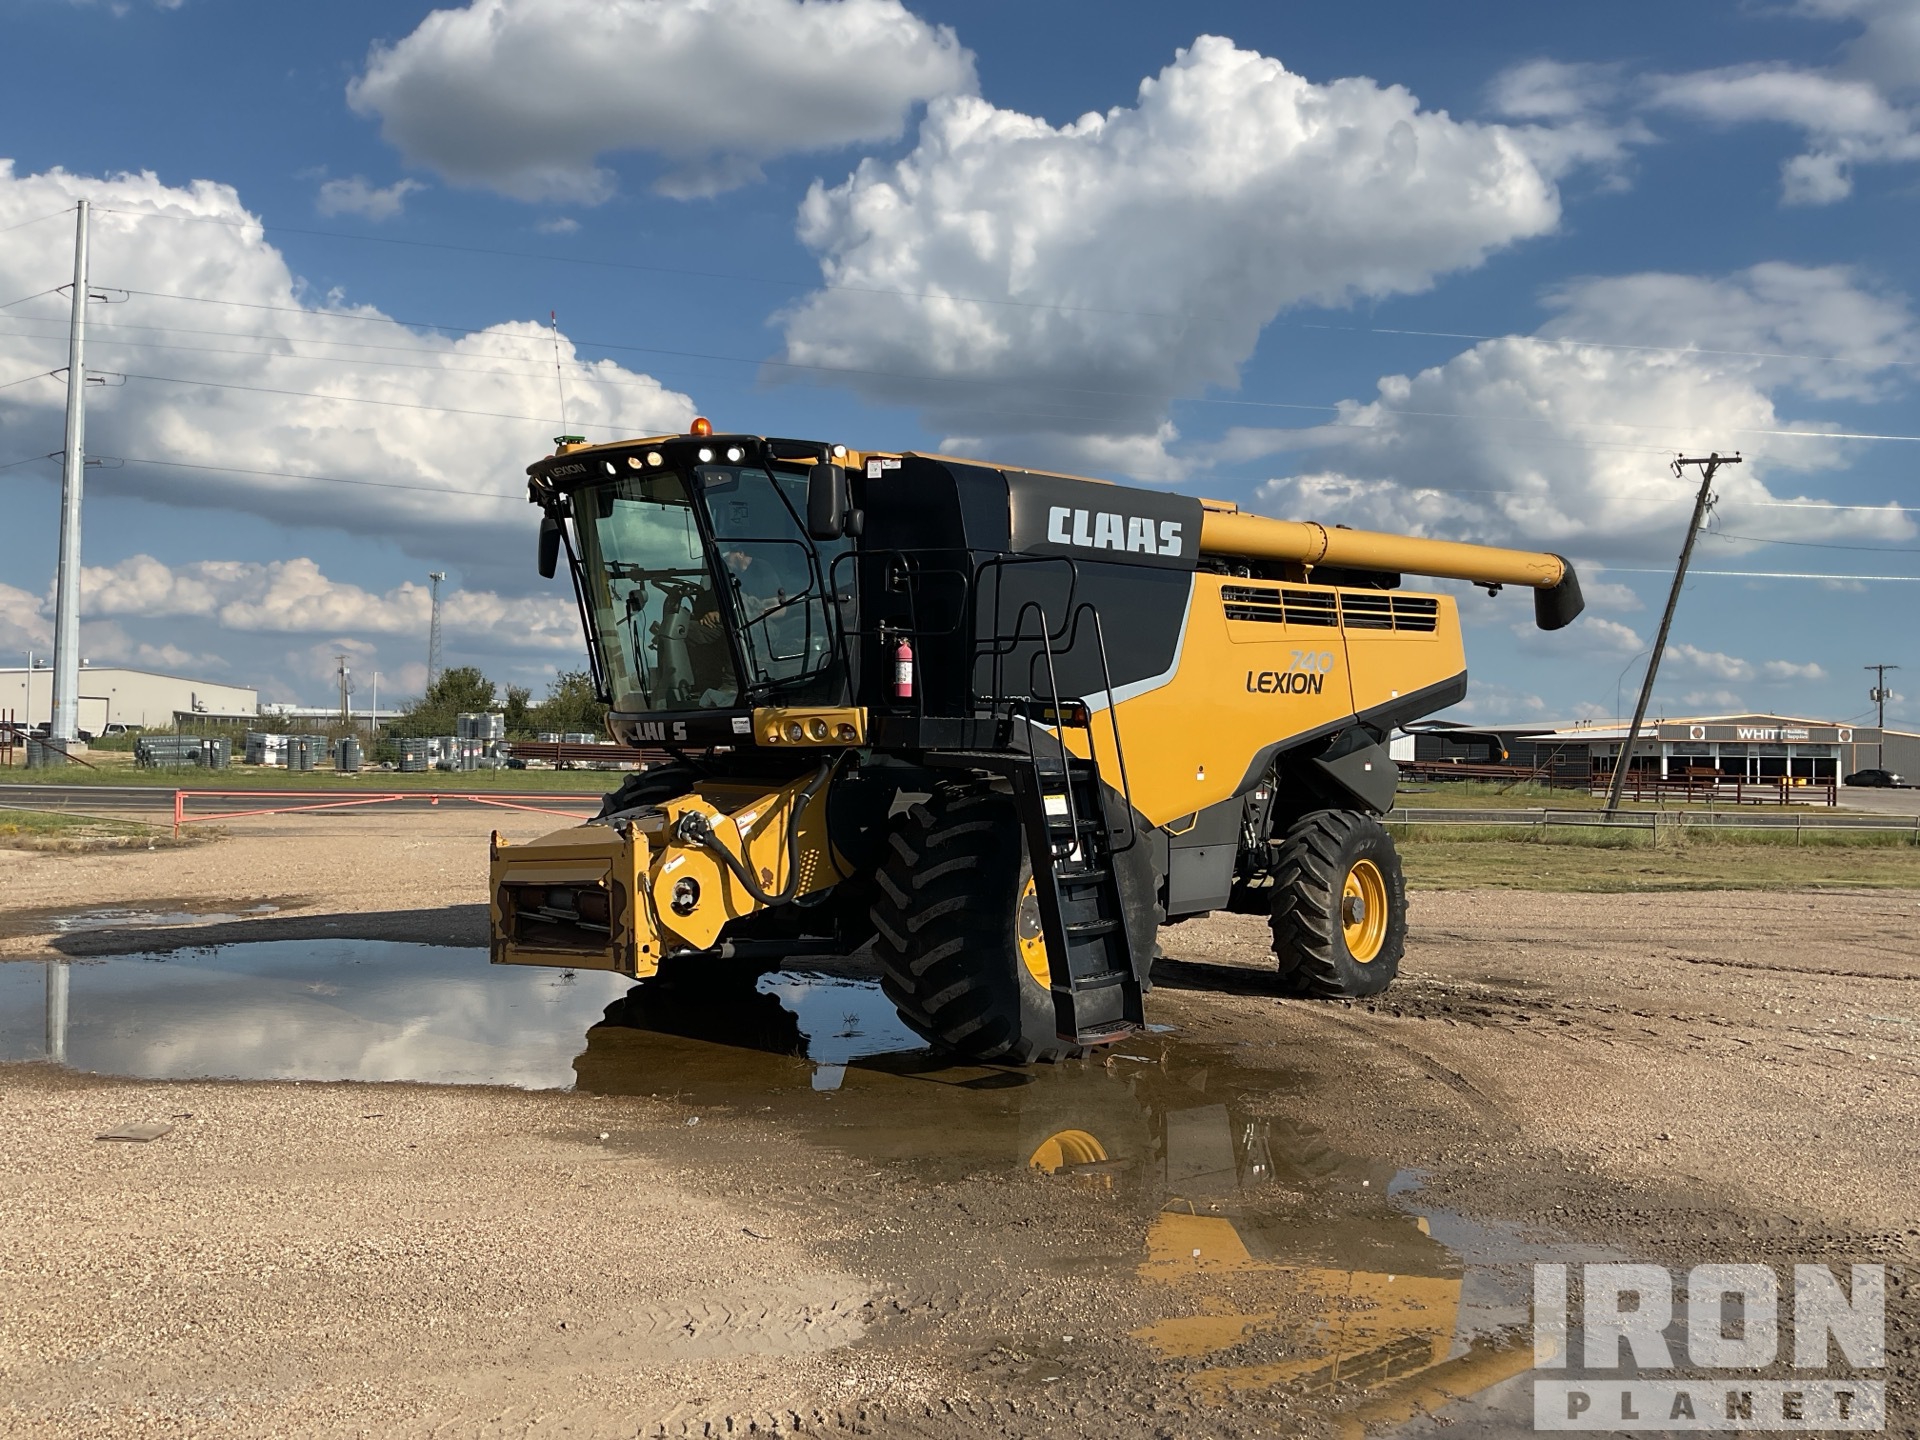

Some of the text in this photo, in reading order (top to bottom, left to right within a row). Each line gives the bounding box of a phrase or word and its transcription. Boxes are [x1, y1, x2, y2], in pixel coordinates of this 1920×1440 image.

[550, 463, 587, 477] LEXION
[1047, 506, 1182, 557] CLAAS
[1289, 649, 1334, 673] 740
[1246, 670, 1325, 695] LEXION
[1738, 729, 1786, 739] WHITT
